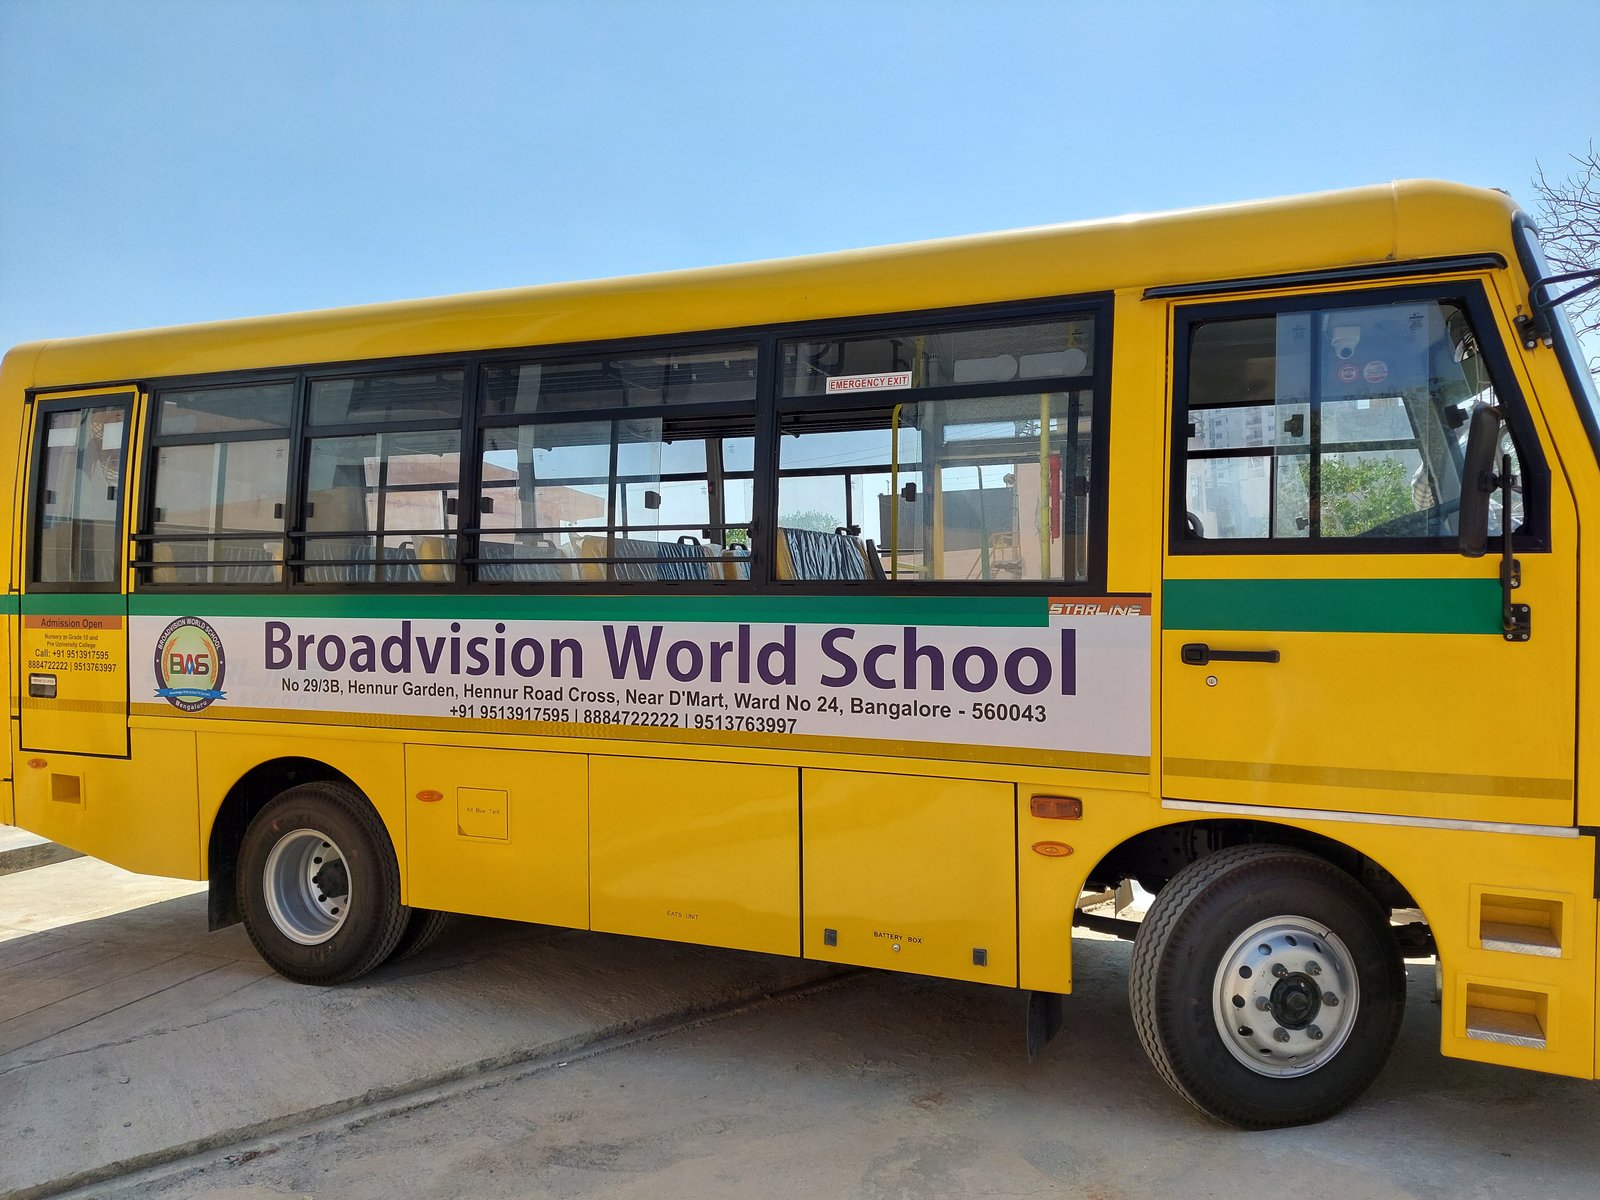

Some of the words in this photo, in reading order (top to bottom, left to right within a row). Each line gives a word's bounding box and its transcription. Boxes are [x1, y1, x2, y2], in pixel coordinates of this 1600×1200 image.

[830, 378, 885, 390] EMERGENCY
[887, 377, 907, 385] EXIT
[1049, 603, 1143, 616] STARLINE
[41, 618, 80, 628] Admission
[82, 618, 103, 630] Open
[157, 618, 186, 650] BROADVISION
[186, 618, 206, 629] WORLD
[205, 625, 222, 650] SCHOOL
[35, 648, 50, 657] Call:
[52, 649, 65, 658] +91
[67, 650, 109, 660] 9513917595
[264, 620, 583, 679] Broadvision
[602, 624, 797, 686] World
[820, 626, 1077, 696] School
[28, 660, 68, 670] 8884722222
[74, 662, 116, 672] 9513763997
[175, 700, 208, 711] Bengaluru
[281, 677, 299, 692] No
[303, 678, 345, 695] 29/3B,
[348, 680, 398, 696] Hennur
[402, 681, 459, 700] Garden,
[464, 683, 519, 700] Hennur
[523, 685, 563, 701] Road
[568, 686, 620, 706] Cross,
[625, 688, 664, 705] Near
[669, 690, 729, 710] D'Mart,
[734, 692, 780, 711] Ward
[786, 694, 811, 712] No
[817, 696, 844, 716] 24,
[850, 697, 951, 720] Bangalore
[972, 703, 1047, 723] 560043
[450, 704, 475, 719] +91
[480, 706, 570, 723] 9513917595
[583, 710, 679, 729] 8884722222
[694, 713, 798, 735] 9513763997
[874, 931, 903, 941] BATTERY
[907, 936, 922, 944] BOX
